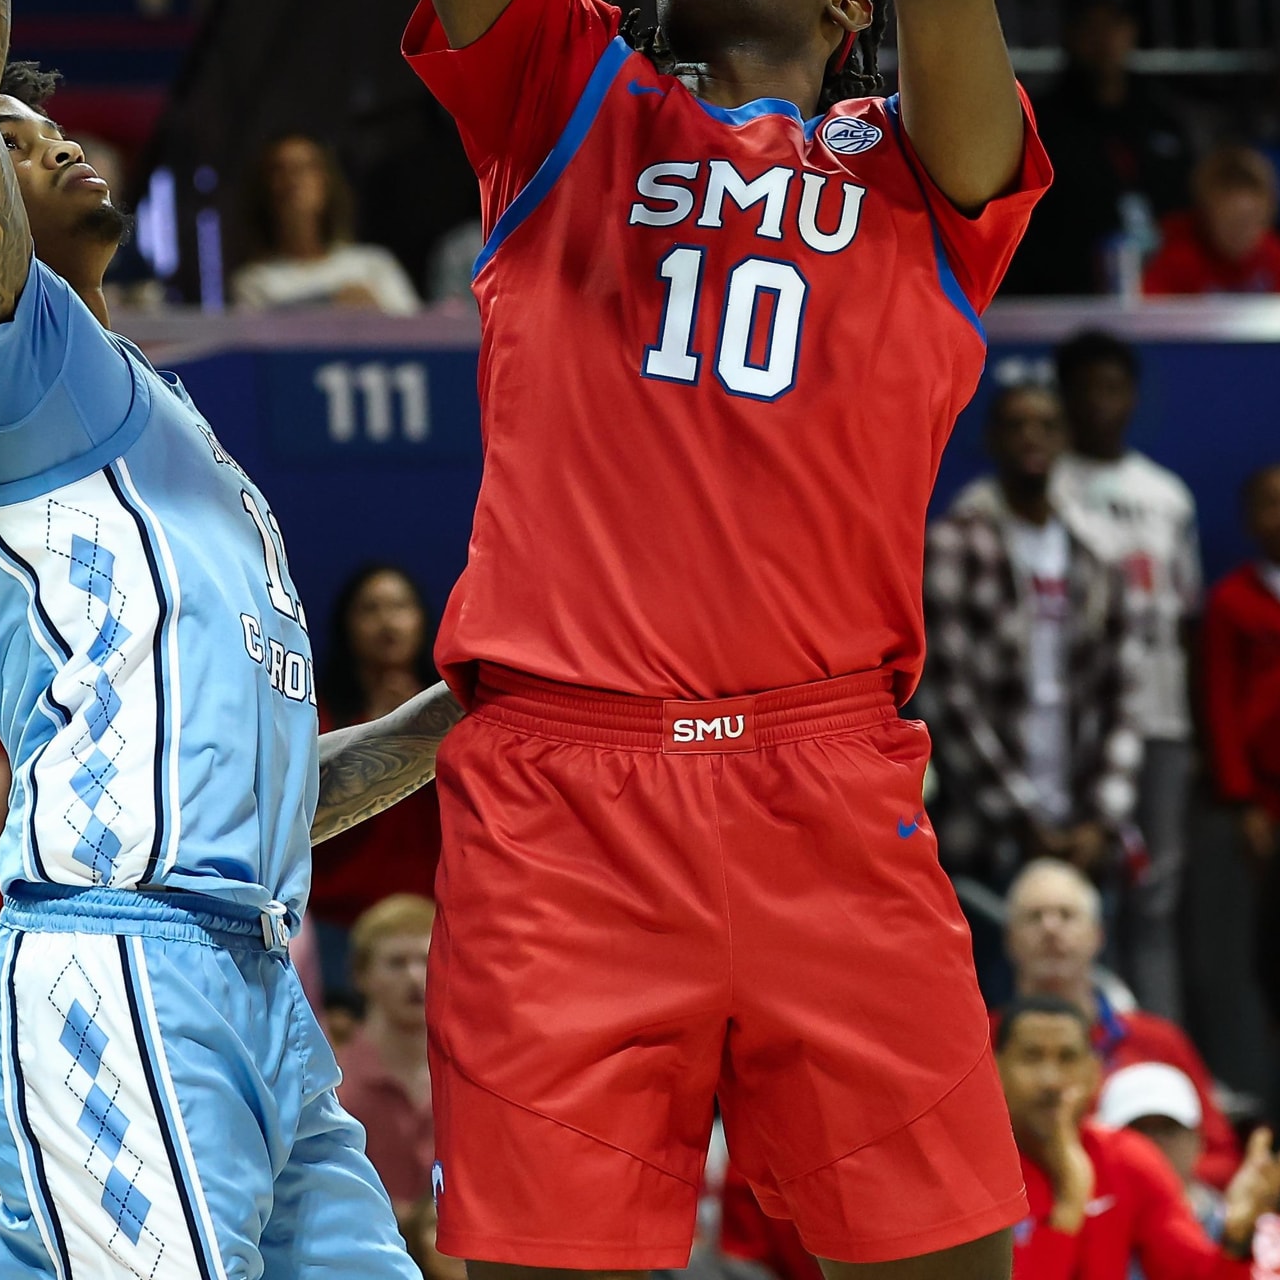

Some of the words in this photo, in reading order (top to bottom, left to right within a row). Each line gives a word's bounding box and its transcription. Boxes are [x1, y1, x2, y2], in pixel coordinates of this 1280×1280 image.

[628, 159, 866, 254] SMU
[640, 243, 810, 403] 10
[315, 362, 429, 443] 111
[673, 714, 744, 742] SMU
